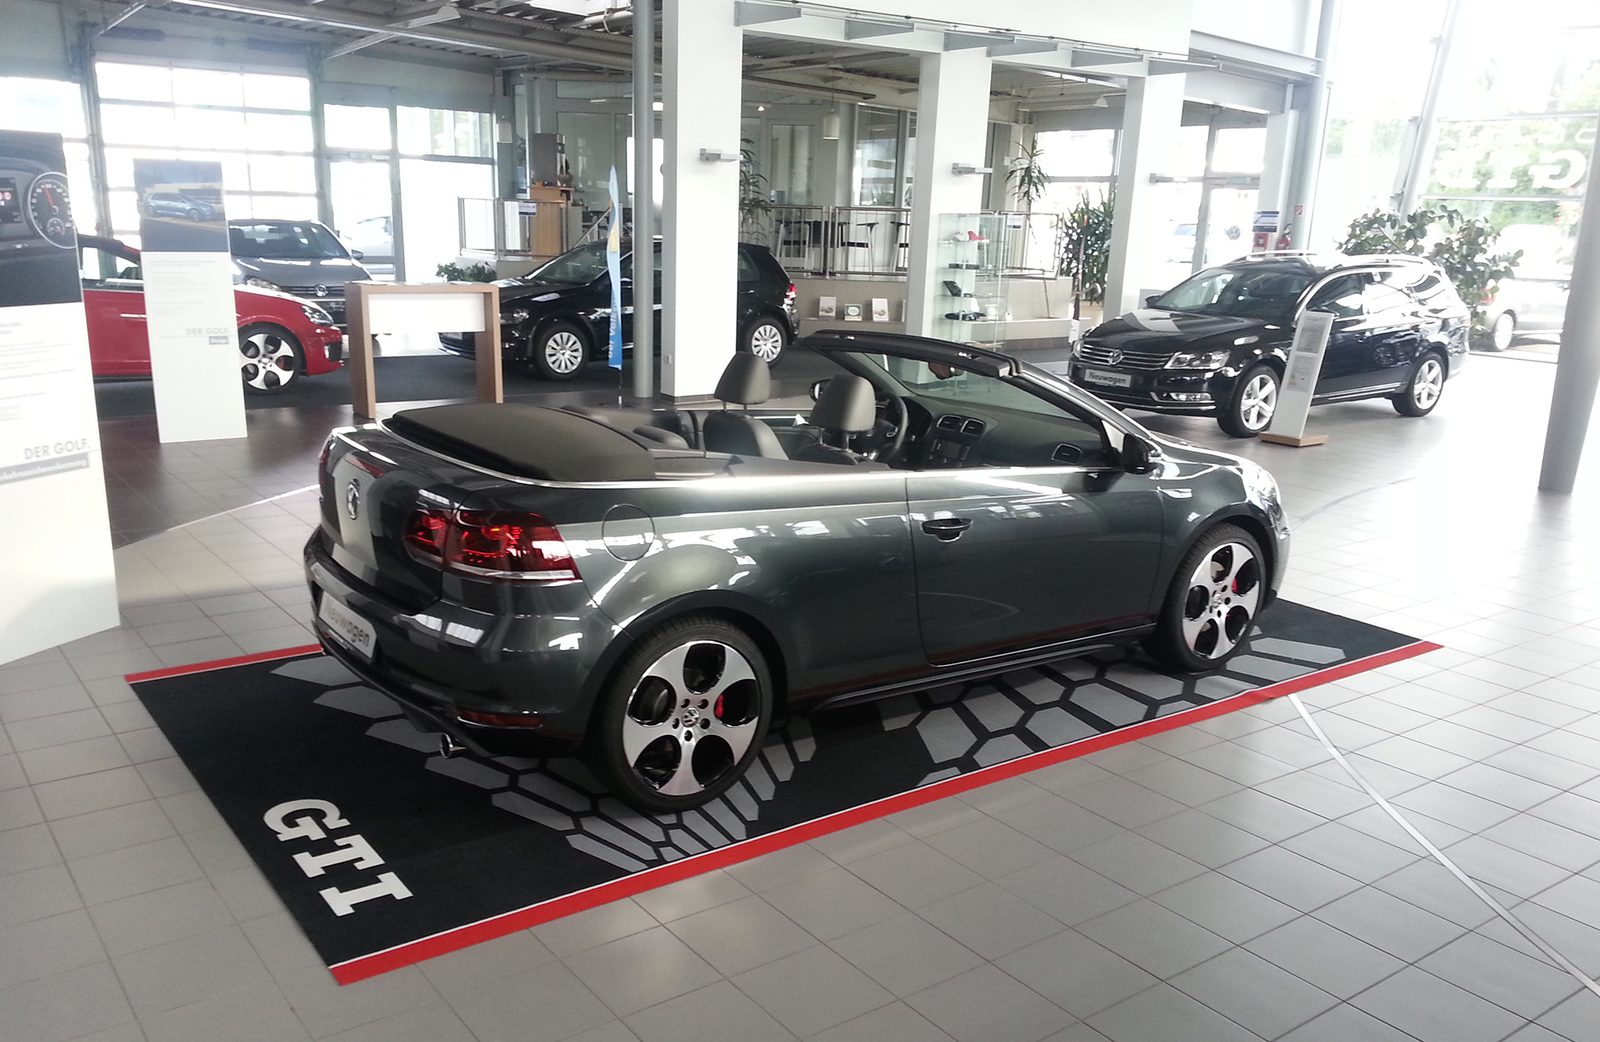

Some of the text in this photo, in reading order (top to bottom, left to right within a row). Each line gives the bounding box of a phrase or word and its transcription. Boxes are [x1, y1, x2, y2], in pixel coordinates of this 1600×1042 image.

[1089, 371, 1127, 385] Neuwagen
[24, 444, 50, 460] DER
[323, 598, 370, 648] Neuwagen
[263, 799, 414, 916] GTI
